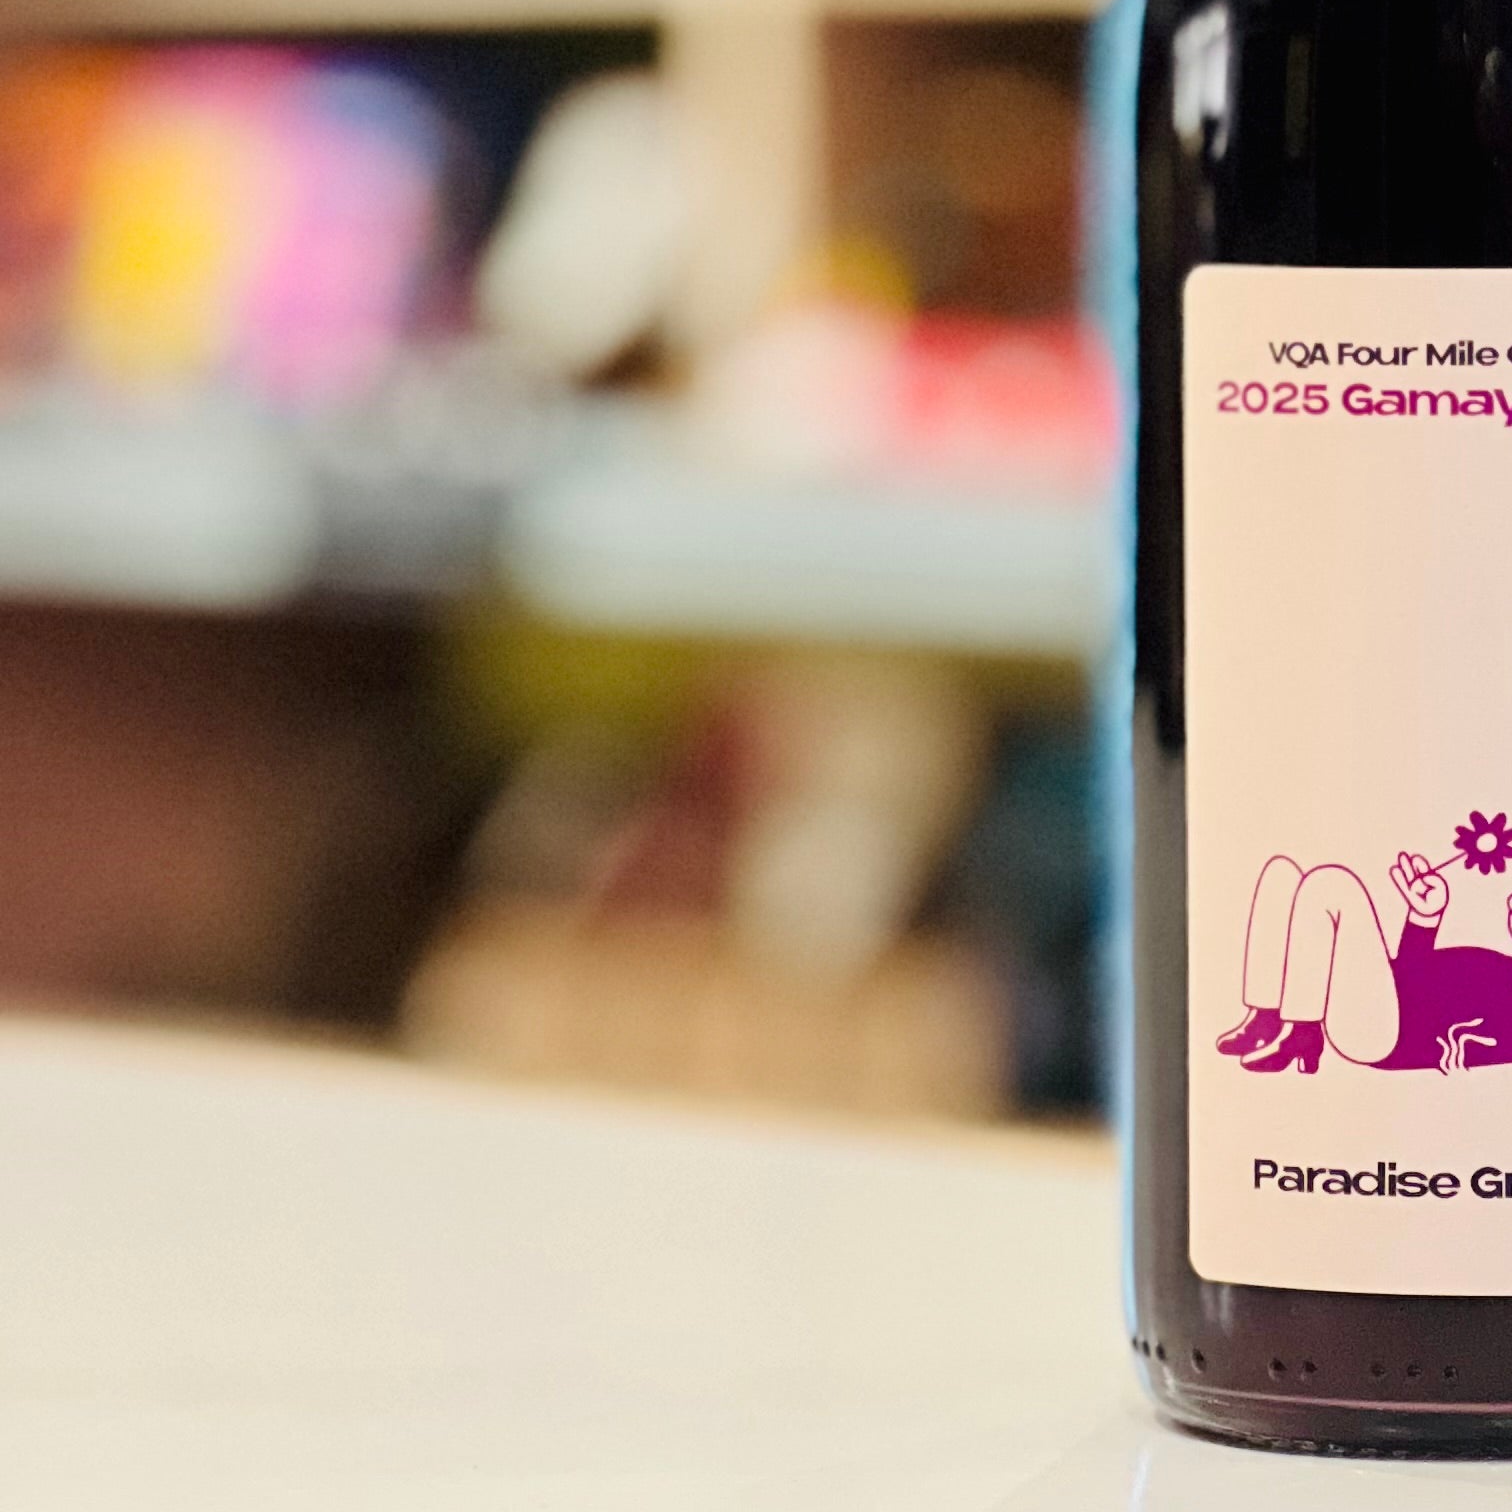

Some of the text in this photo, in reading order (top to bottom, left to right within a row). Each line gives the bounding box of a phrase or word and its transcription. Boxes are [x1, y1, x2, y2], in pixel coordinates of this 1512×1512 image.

[1269, 341, 1330, 368] VQA
[1337, 342, 1418, 367] Four
[1425, 340, 1500, 367] Mile
[1217, 381, 1330, 415] 2025
[1253, 1159, 1460, 1199] Paradise
